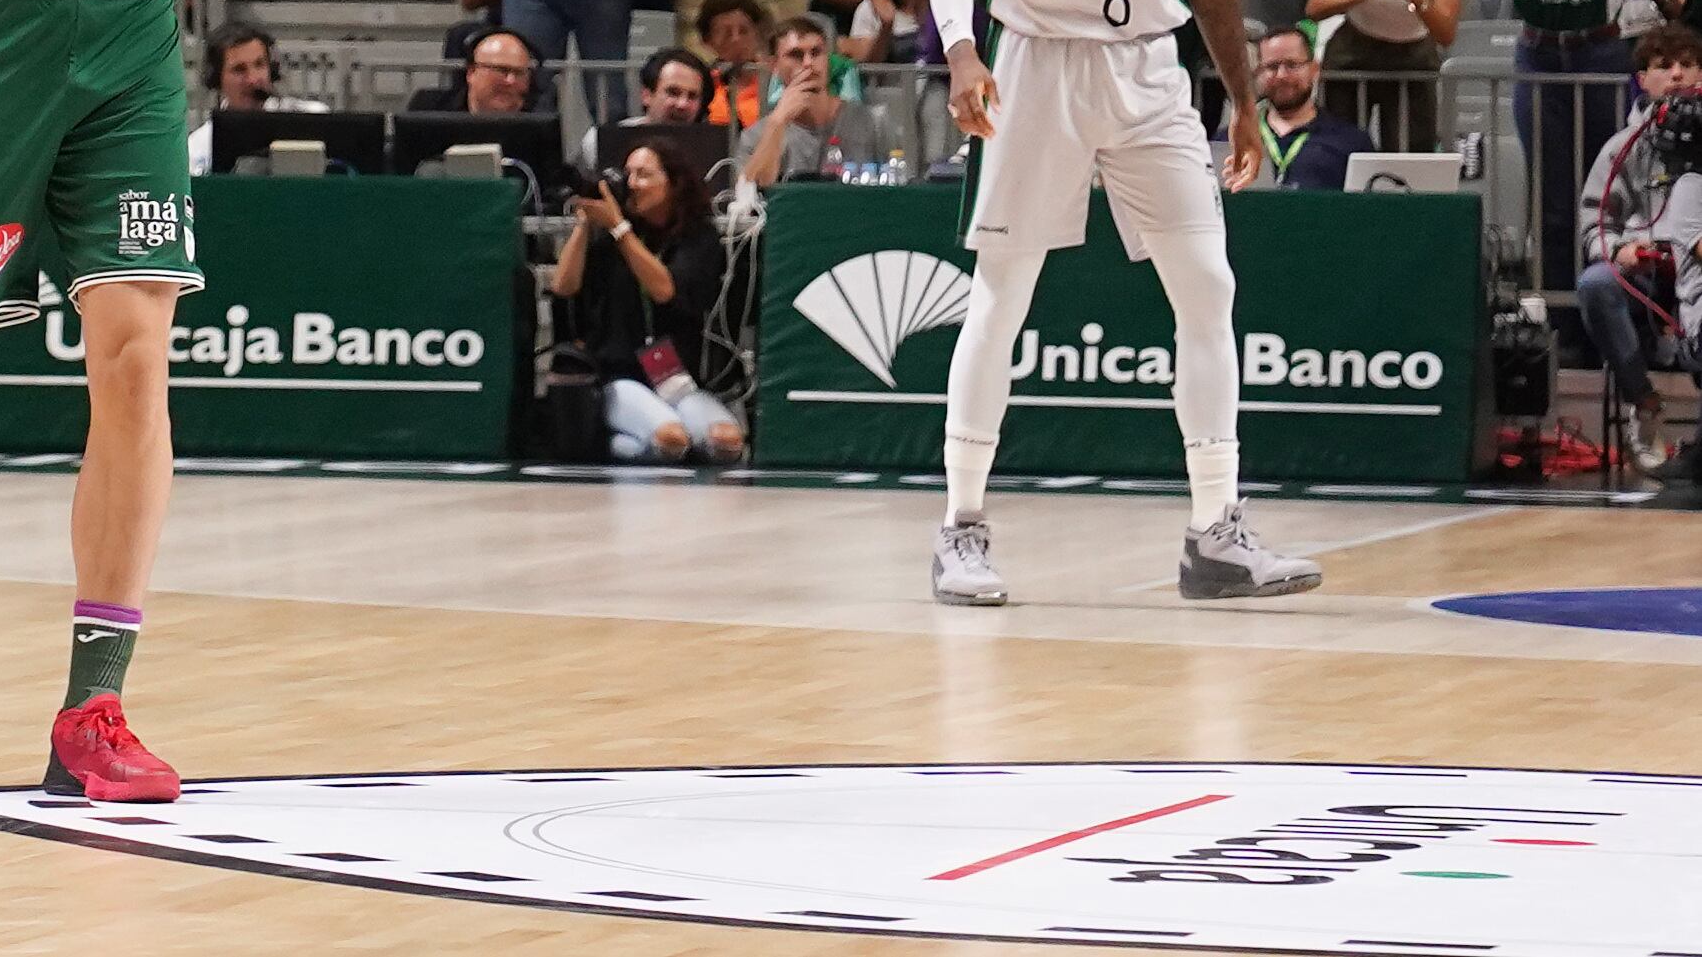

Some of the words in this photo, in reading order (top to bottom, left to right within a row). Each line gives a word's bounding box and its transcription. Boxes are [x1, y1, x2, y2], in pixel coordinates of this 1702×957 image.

[120, 213, 178, 247] laga
[45, 304, 286, 377] Ucaja
[291, 312, 486, 367] Banco
[1010, 322, 1177, 385] Unica
[1242, 332, 1444, 390] Banco
